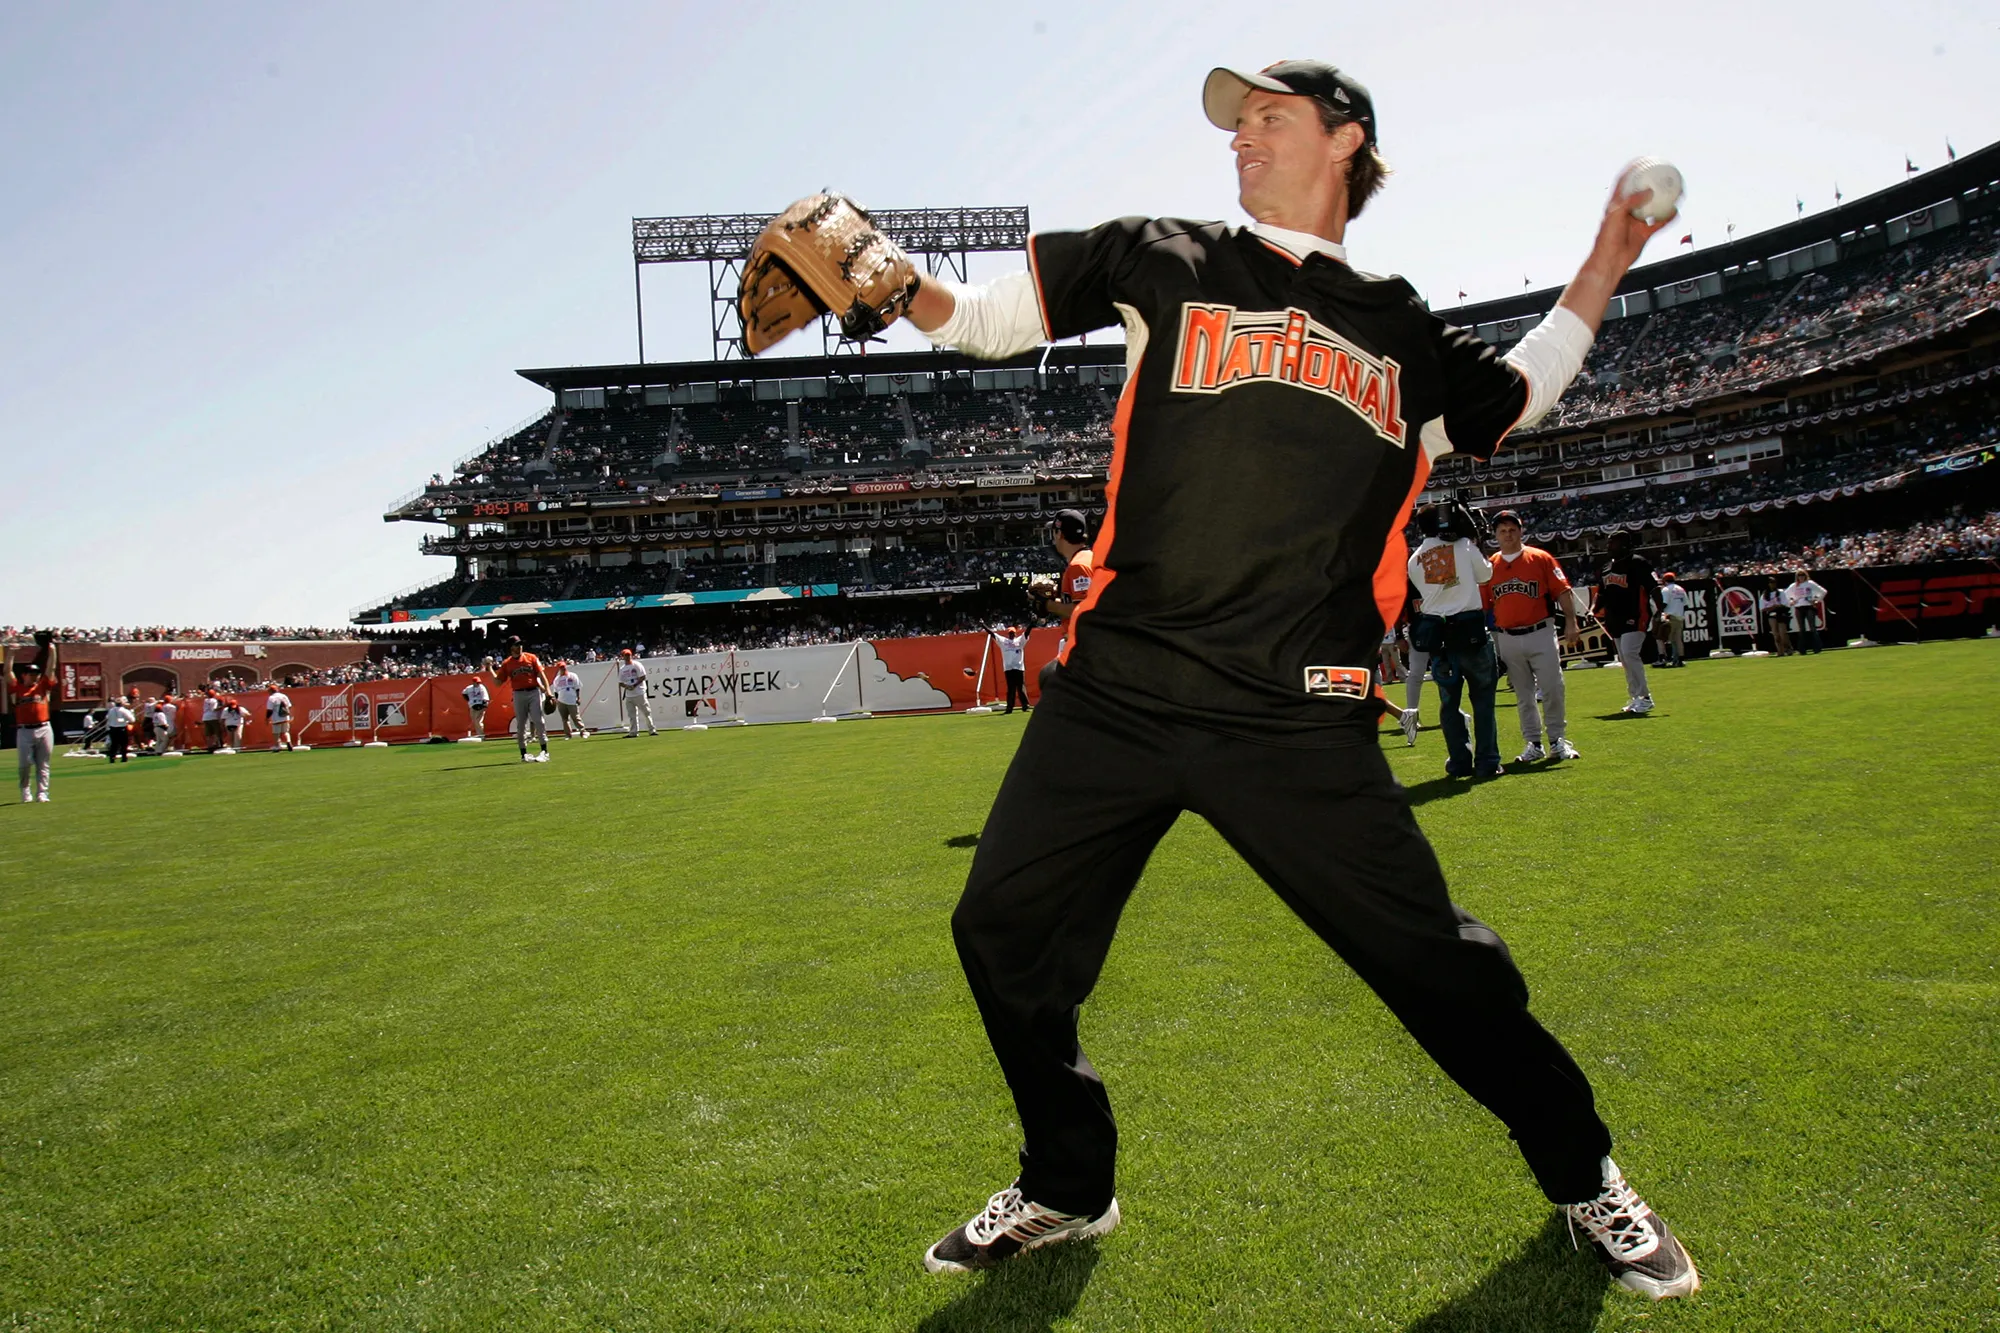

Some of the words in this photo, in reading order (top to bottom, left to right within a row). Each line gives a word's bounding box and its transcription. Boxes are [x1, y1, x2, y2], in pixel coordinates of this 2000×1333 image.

[1171, 302, 1407, 449] NATIONAL
[979, 477, 1029, 486] FusionStorm
[869, 483, 905, 492] TOYOTA
[514, 502, 529, 512] PM
[1721, 618, 1754, 626] TACO
[1724, 625, 1756, 633] BELL
[170, 649, 218, 659] KRAGEN
[677, 660, 750, 672] FRANCISCO
[718, 670, 782, 694] WEEK
[321, 694, 349, 708] THINK
[309, 708, 348, 721] OUTSIDE
